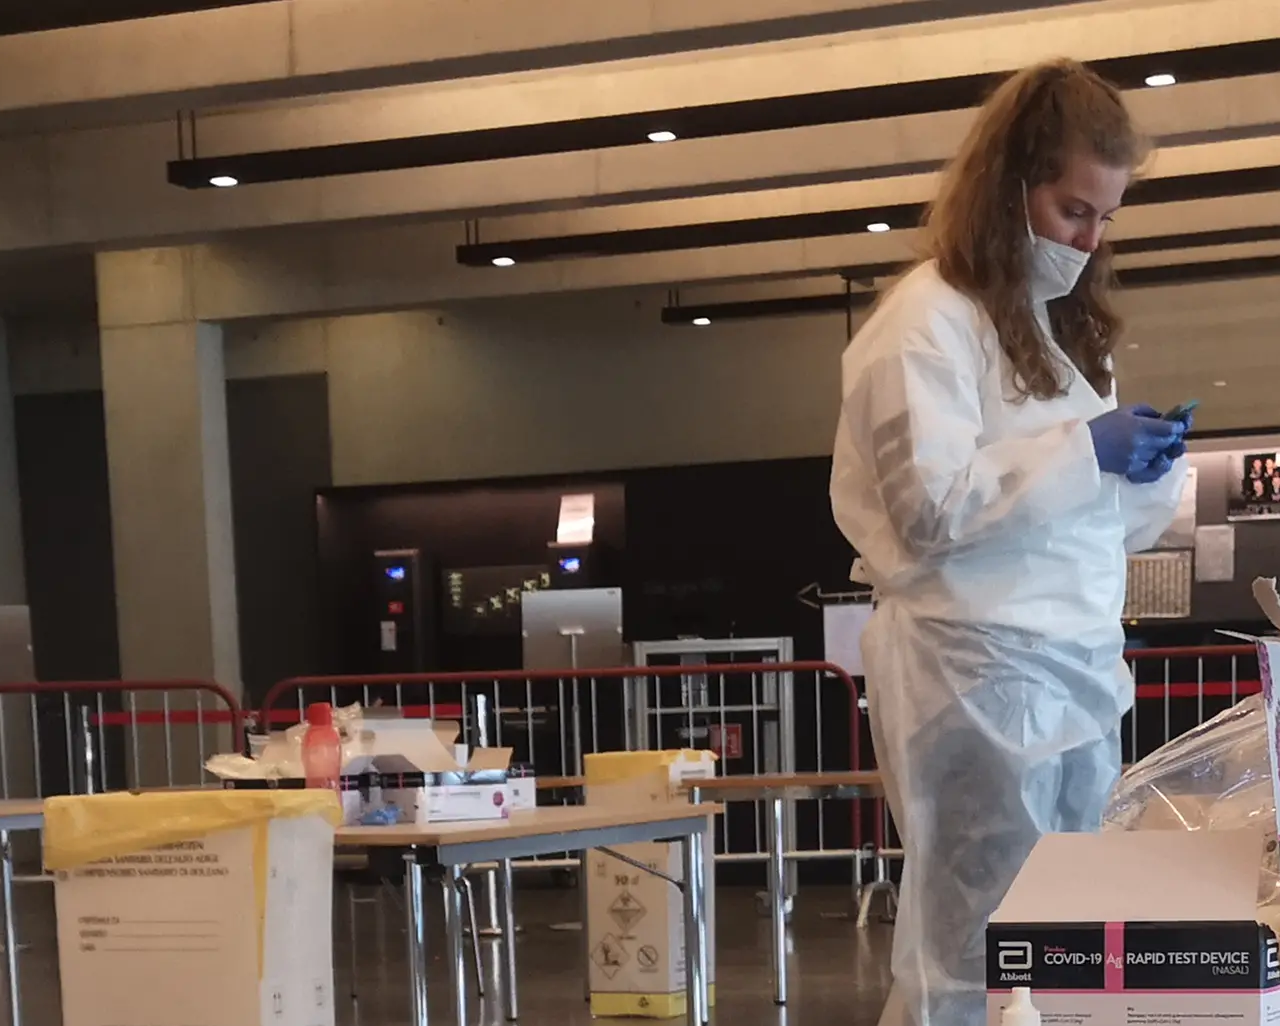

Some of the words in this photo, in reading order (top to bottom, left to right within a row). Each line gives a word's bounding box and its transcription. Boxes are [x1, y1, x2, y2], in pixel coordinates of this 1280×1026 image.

[1043, 953, 1103, 966] COVID-19
[1126, 952, 1166, 965] RAPID
[1168, 952, 1199, 965] TEST
[1200, 951, 1250, 965] DEVICE
[1000, 972, 1033, 982] Abbott
